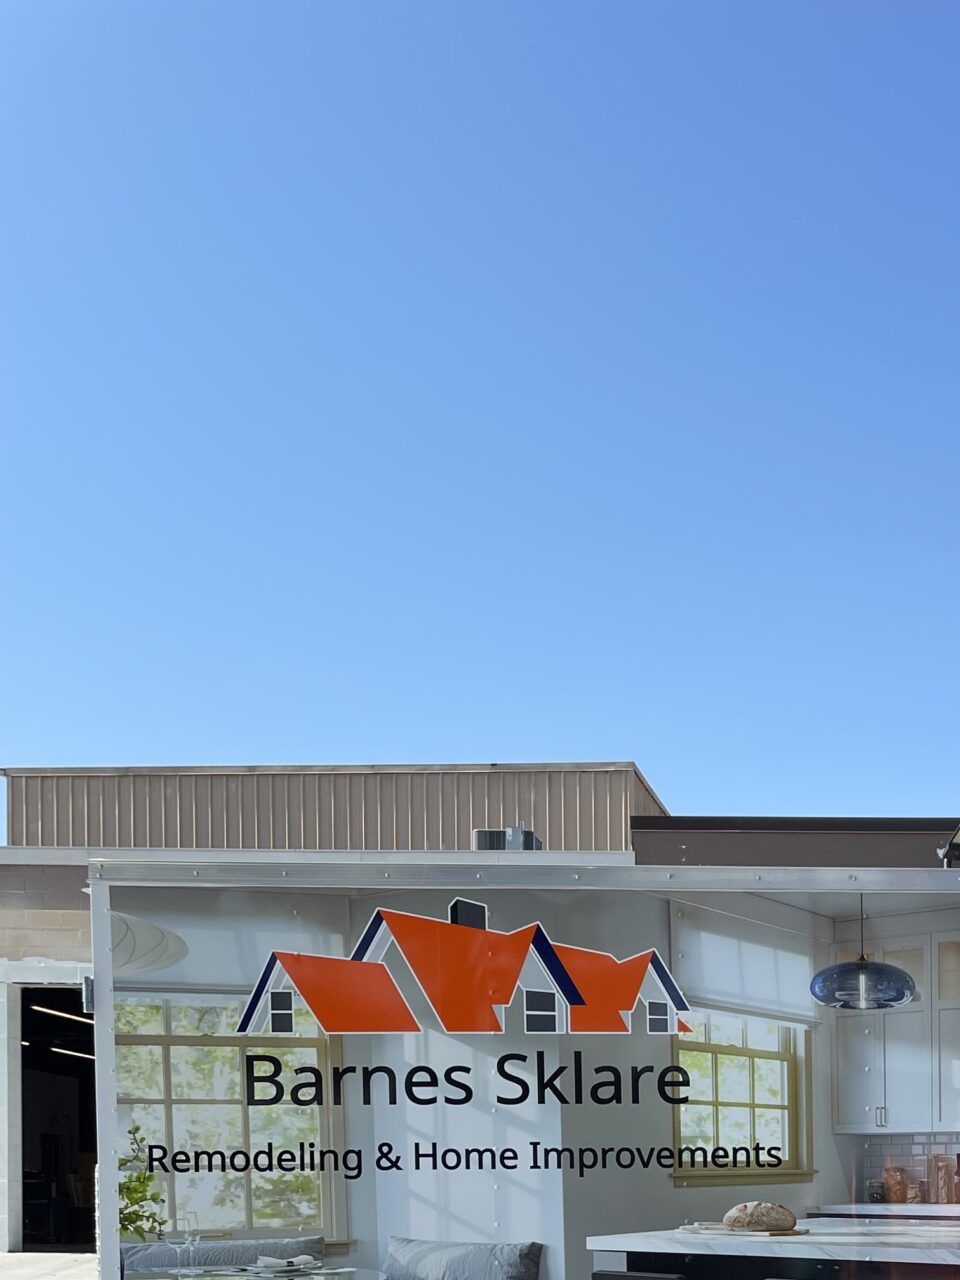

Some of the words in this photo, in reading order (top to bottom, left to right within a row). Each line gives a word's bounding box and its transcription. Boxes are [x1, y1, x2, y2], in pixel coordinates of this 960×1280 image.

[245, 1054, 473, 1107] Barnes
[496, 1050, 691, 1106] Sklare
[148, 1141, 363, 1180] Remodeling
[375, 1142, 403, 1171] &
[414, 1142, 519, 1170] Home
[529, 1141, 783, 1180] Improvements
